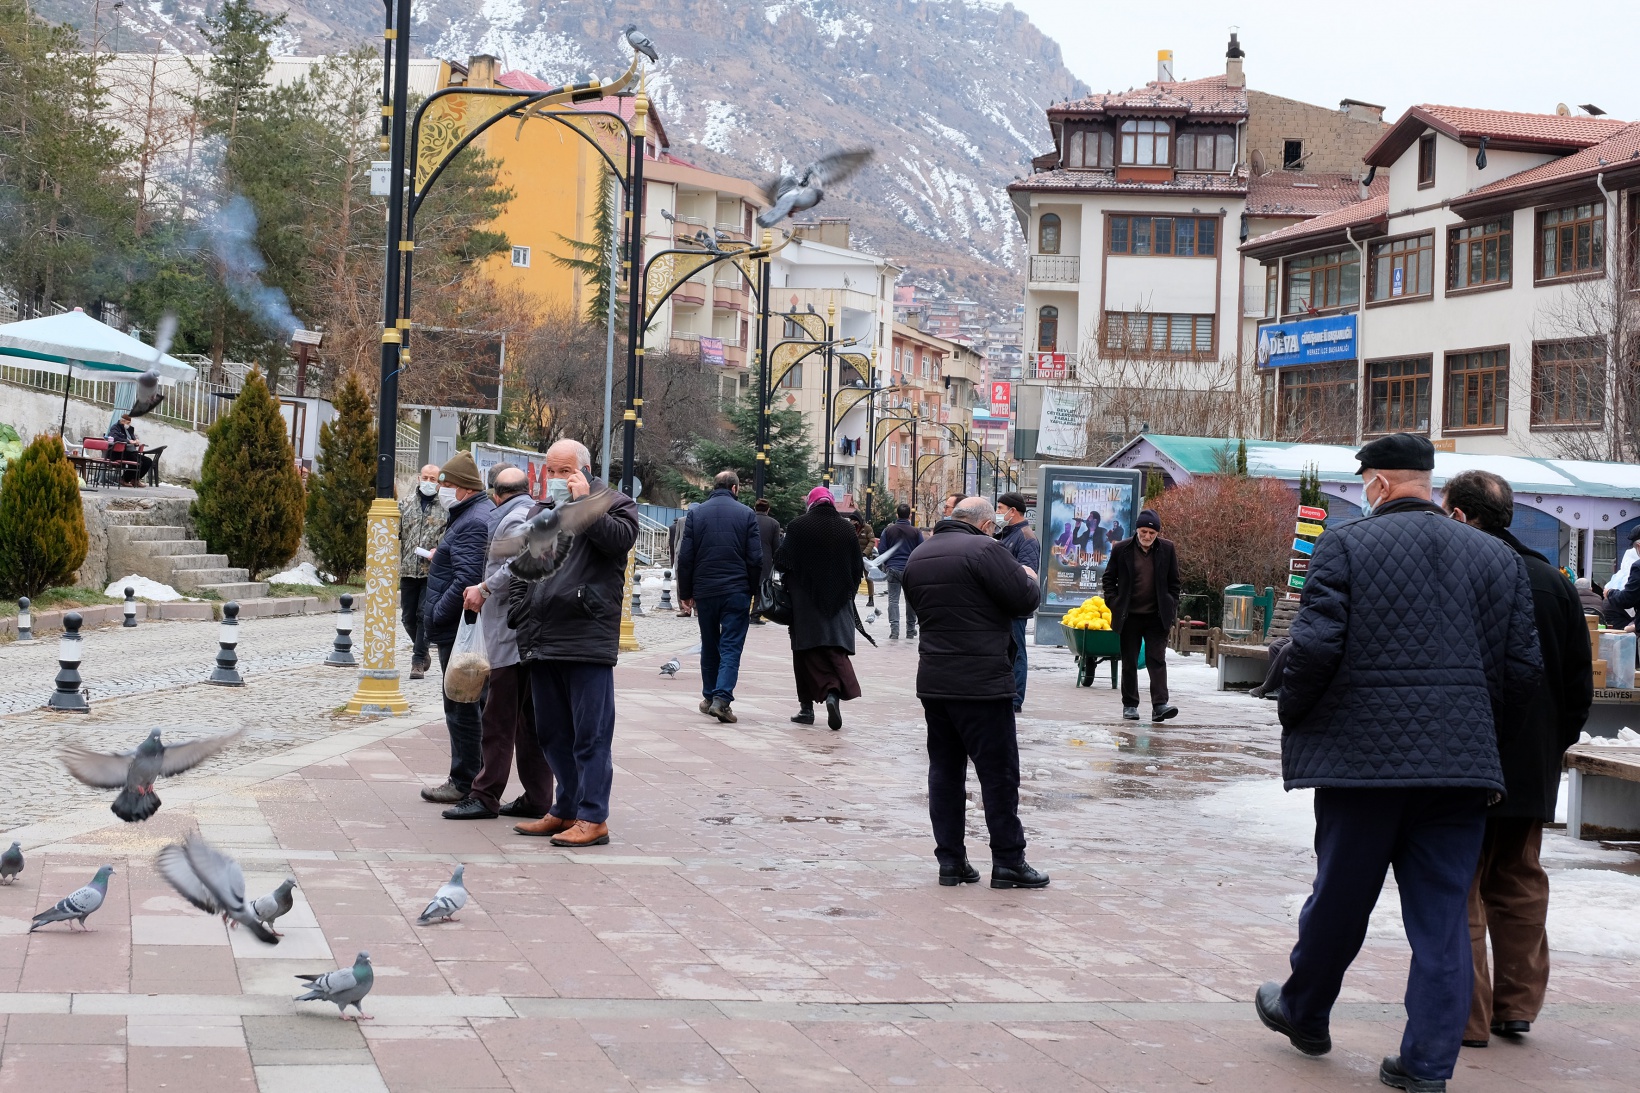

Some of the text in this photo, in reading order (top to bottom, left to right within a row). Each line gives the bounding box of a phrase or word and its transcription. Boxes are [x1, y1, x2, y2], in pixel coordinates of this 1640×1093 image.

[1270, 335, 1300, 354] DEVA
[1307, 348, 1320, 356] MERKEZ
[1329, 344, 1349, 354] BAŞKANLIĞI
[1039, 370, 1063, 378] NOTER
[995, 385, 1007, 401] 2.
[991, 402, 1009, 415] NOTER
